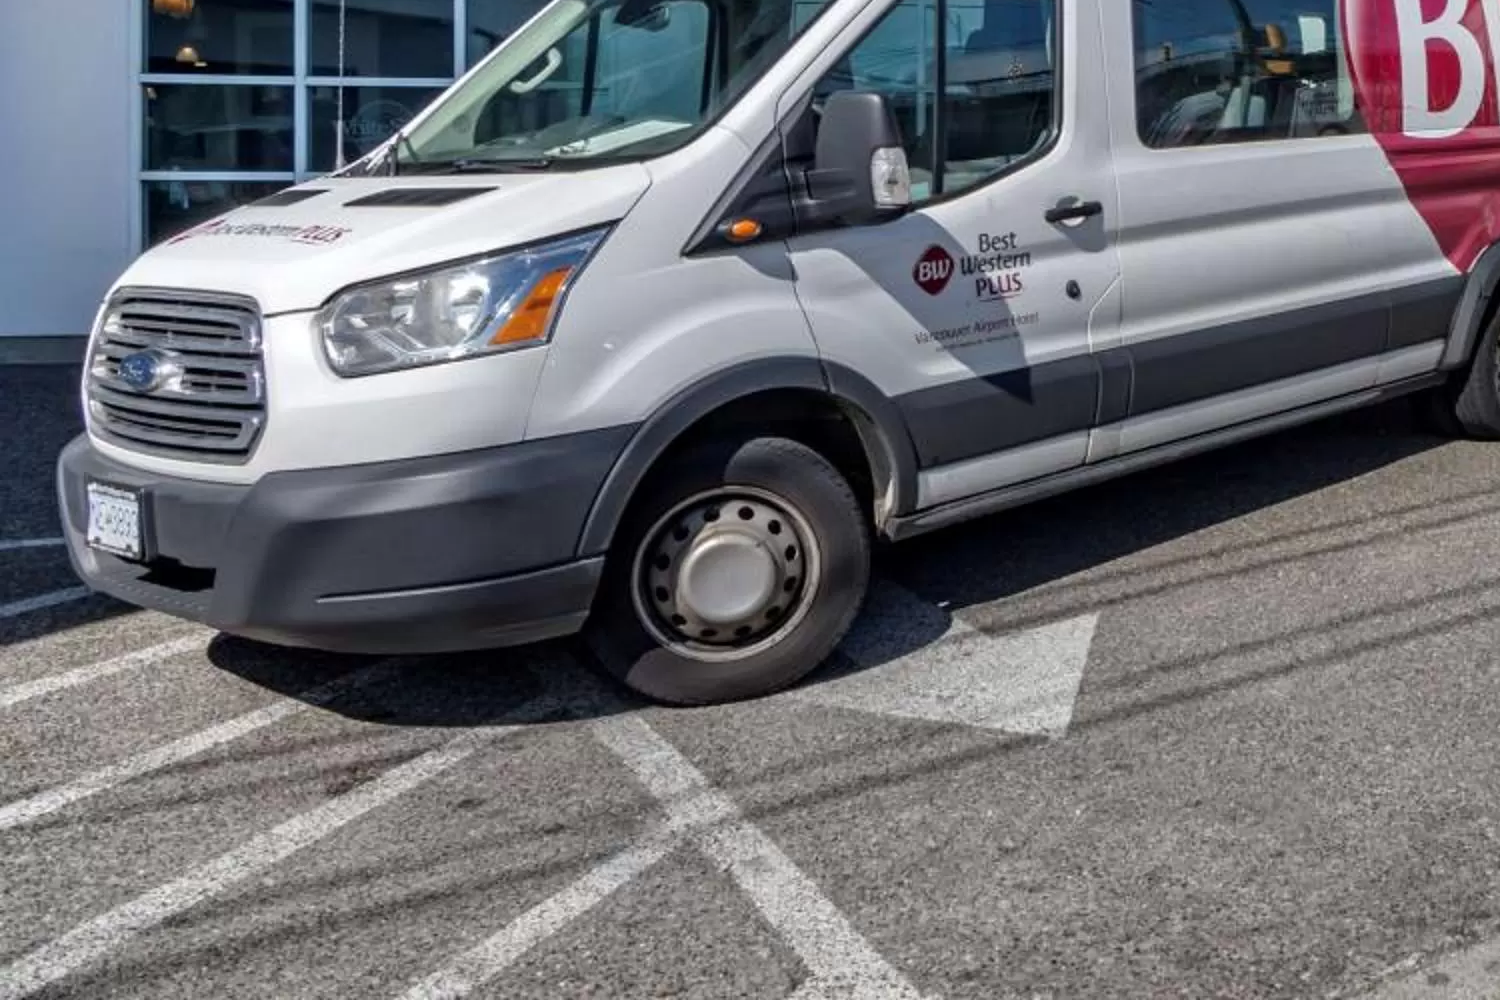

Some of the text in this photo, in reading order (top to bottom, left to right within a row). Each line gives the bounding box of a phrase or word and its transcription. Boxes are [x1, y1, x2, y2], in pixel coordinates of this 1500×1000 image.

[979, 232, 1017, 252] Best
[918, 258, 951, 281] BW
[960, 251, 1032, 276] Western
[976, 272, 1023, 297] PLUS
